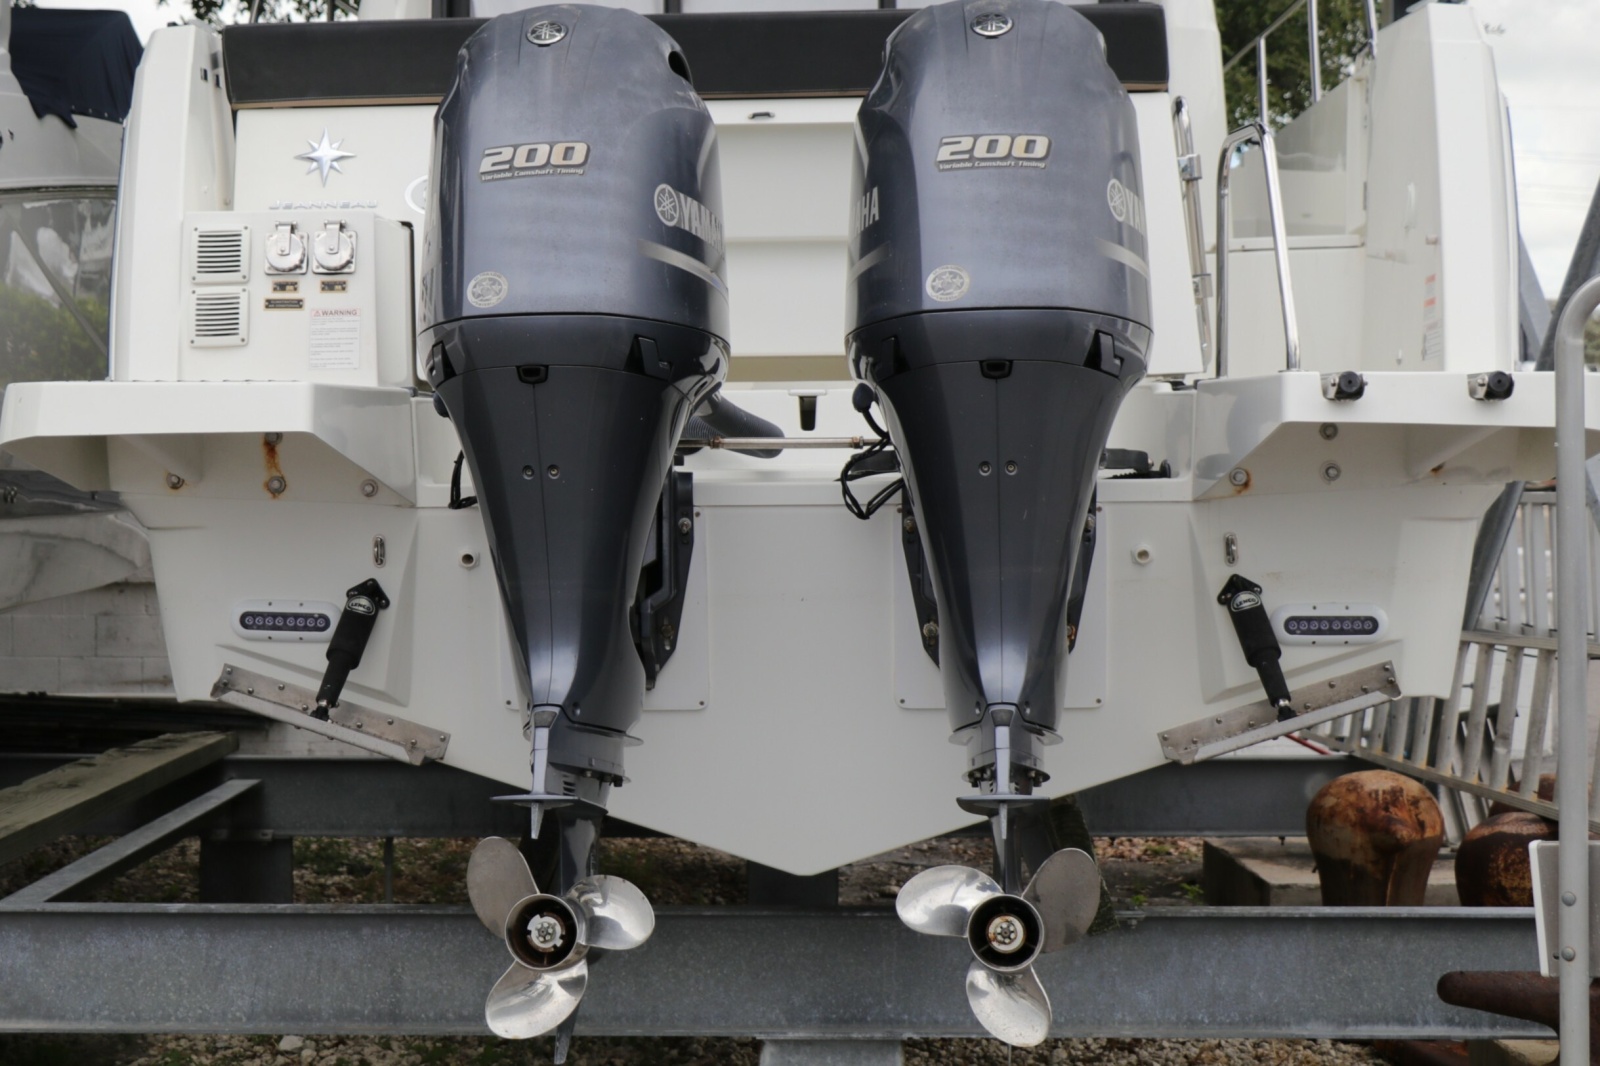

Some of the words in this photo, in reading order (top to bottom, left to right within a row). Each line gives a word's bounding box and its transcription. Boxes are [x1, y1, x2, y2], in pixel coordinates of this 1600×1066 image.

[936, 134, 1050, 161] 200
[479, 142, 588, 173] 200
[939, 161, 973, 170] Variable
[481, 172, 513, 181] Variable
[514, 168, 554, 177] Camshaft
[557, 167, 584, 175] Timing
[350, 602, 372, 612] LENCO
